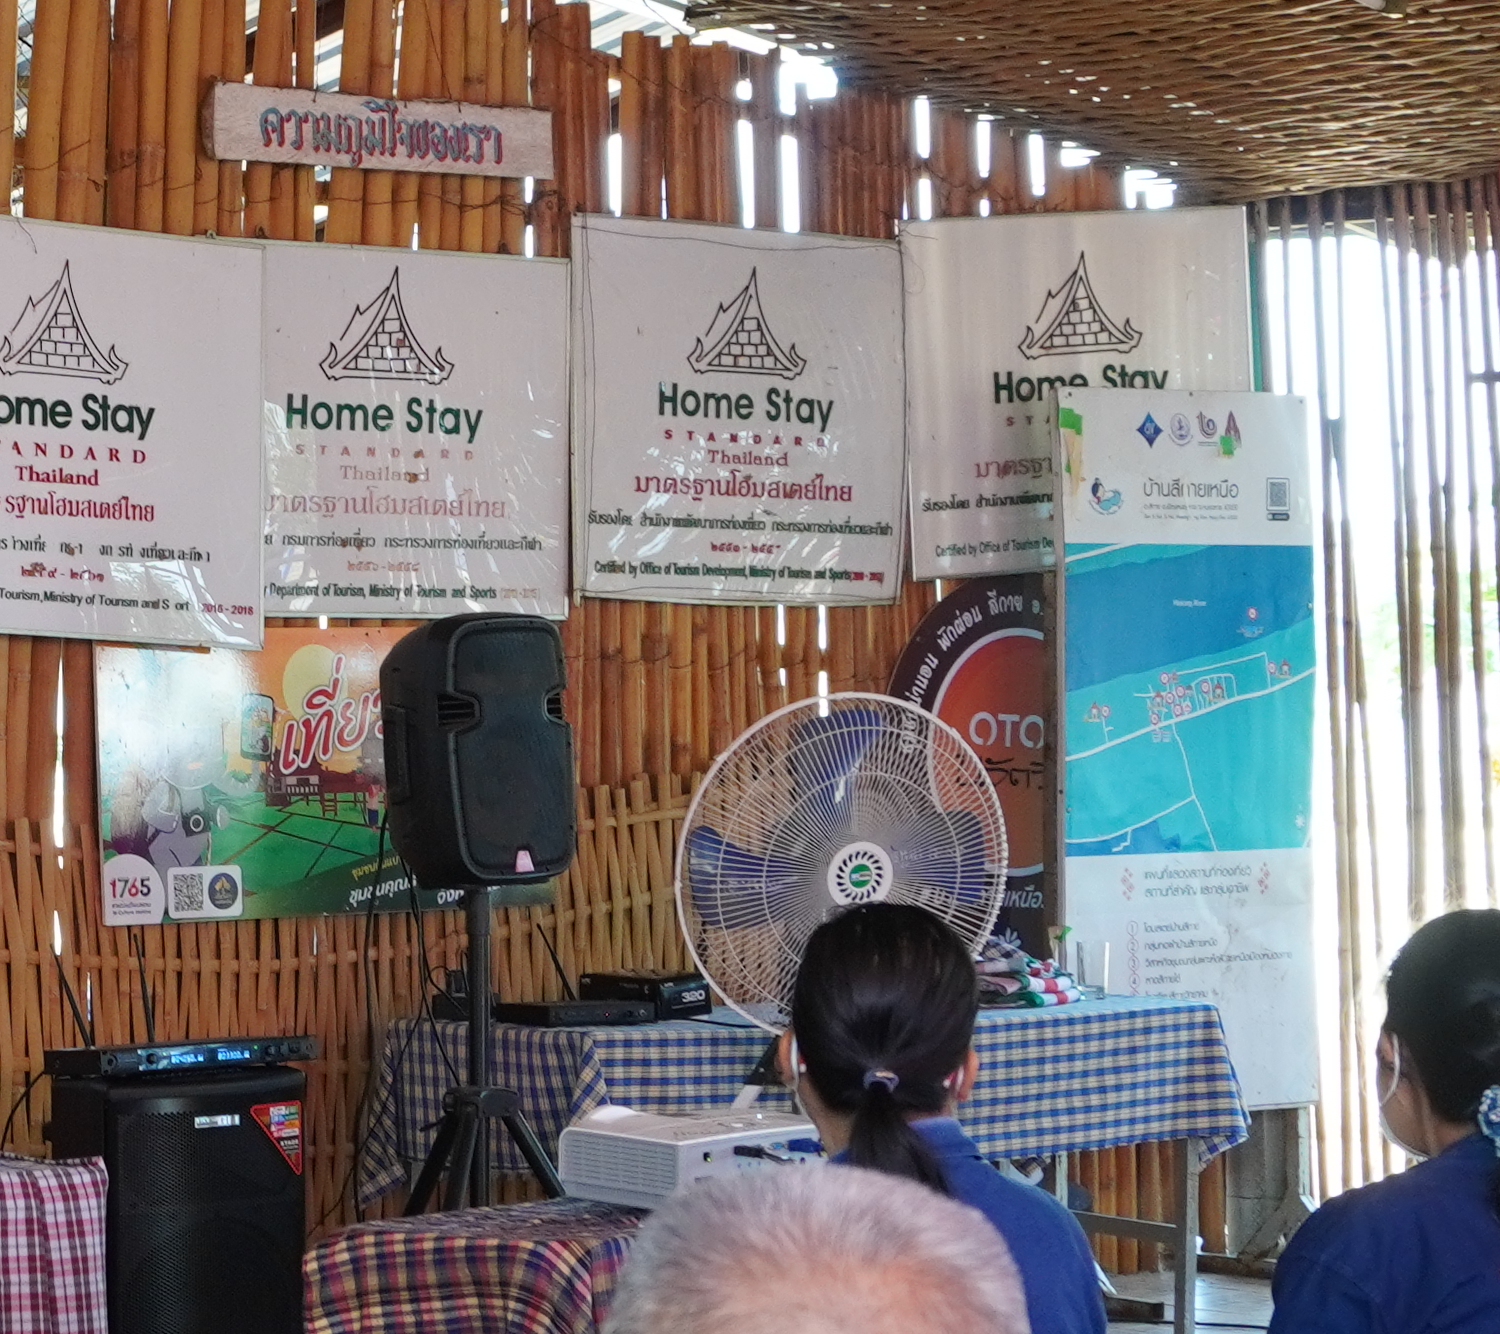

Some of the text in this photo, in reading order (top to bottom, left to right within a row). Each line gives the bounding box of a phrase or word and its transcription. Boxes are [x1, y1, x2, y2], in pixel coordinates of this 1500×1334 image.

[81, 393, 156, 441] Stay
[657, 381, 834, 435] Home Stay
[285, 394, 484, 444] Home Stay
[707, 448, 789, 467] Thailand
[14, 464, 101, 487] Thailand
[339, 464, 431, 484] Thailand
[968, 543, 978, 558] by
[979, 541, 1000, 555] Office
[628, 560, 638, 578] by
[85, 593, 96, 606] of
[98, 594, 140, 609] Tourism
[369, 583, 400, 601] Ministry
[469, 585, 498, 602] Sports
[968, 710, 1045, 749] OTO
[109, 875, 152, 899] 1765
